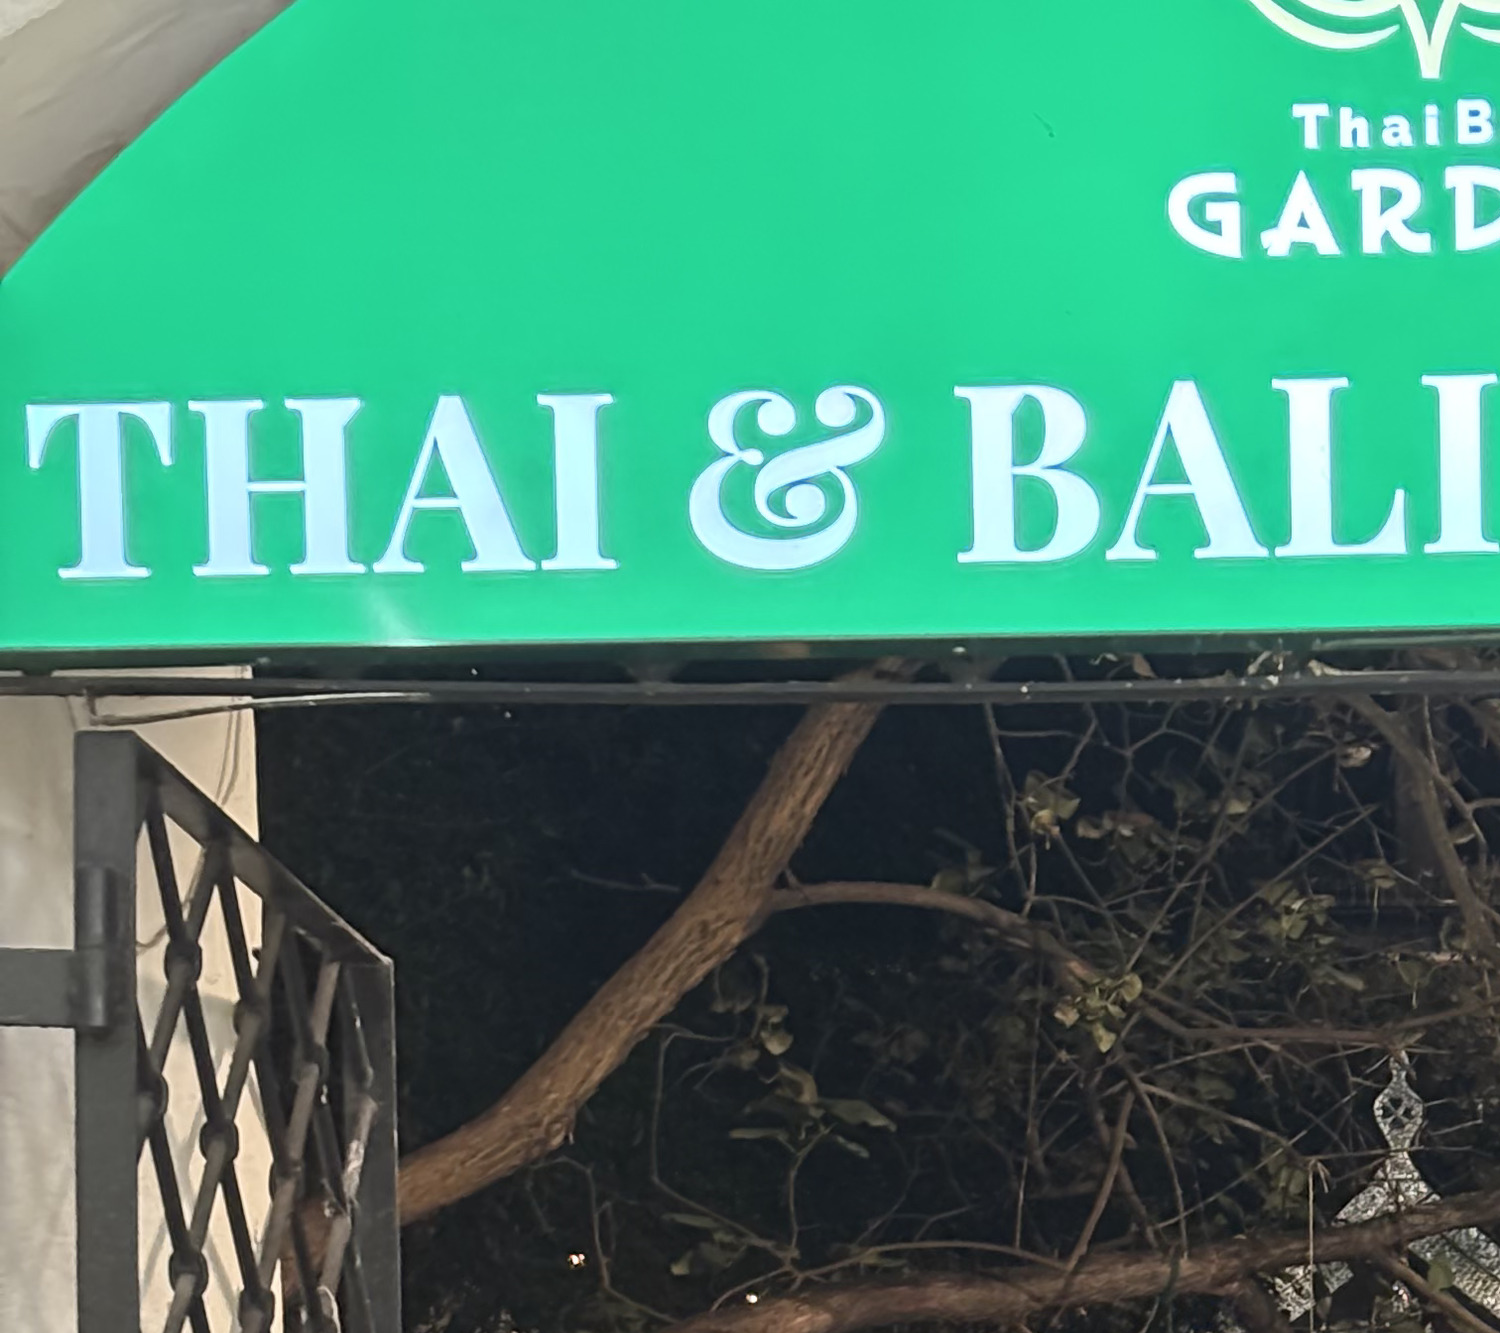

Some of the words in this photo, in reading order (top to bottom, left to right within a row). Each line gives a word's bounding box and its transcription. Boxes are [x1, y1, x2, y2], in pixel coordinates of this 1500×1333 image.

[25, 393, 618, 580] THAI
[688, 385, 887, 571] &
[952, 373, 1500, 564] BALI
